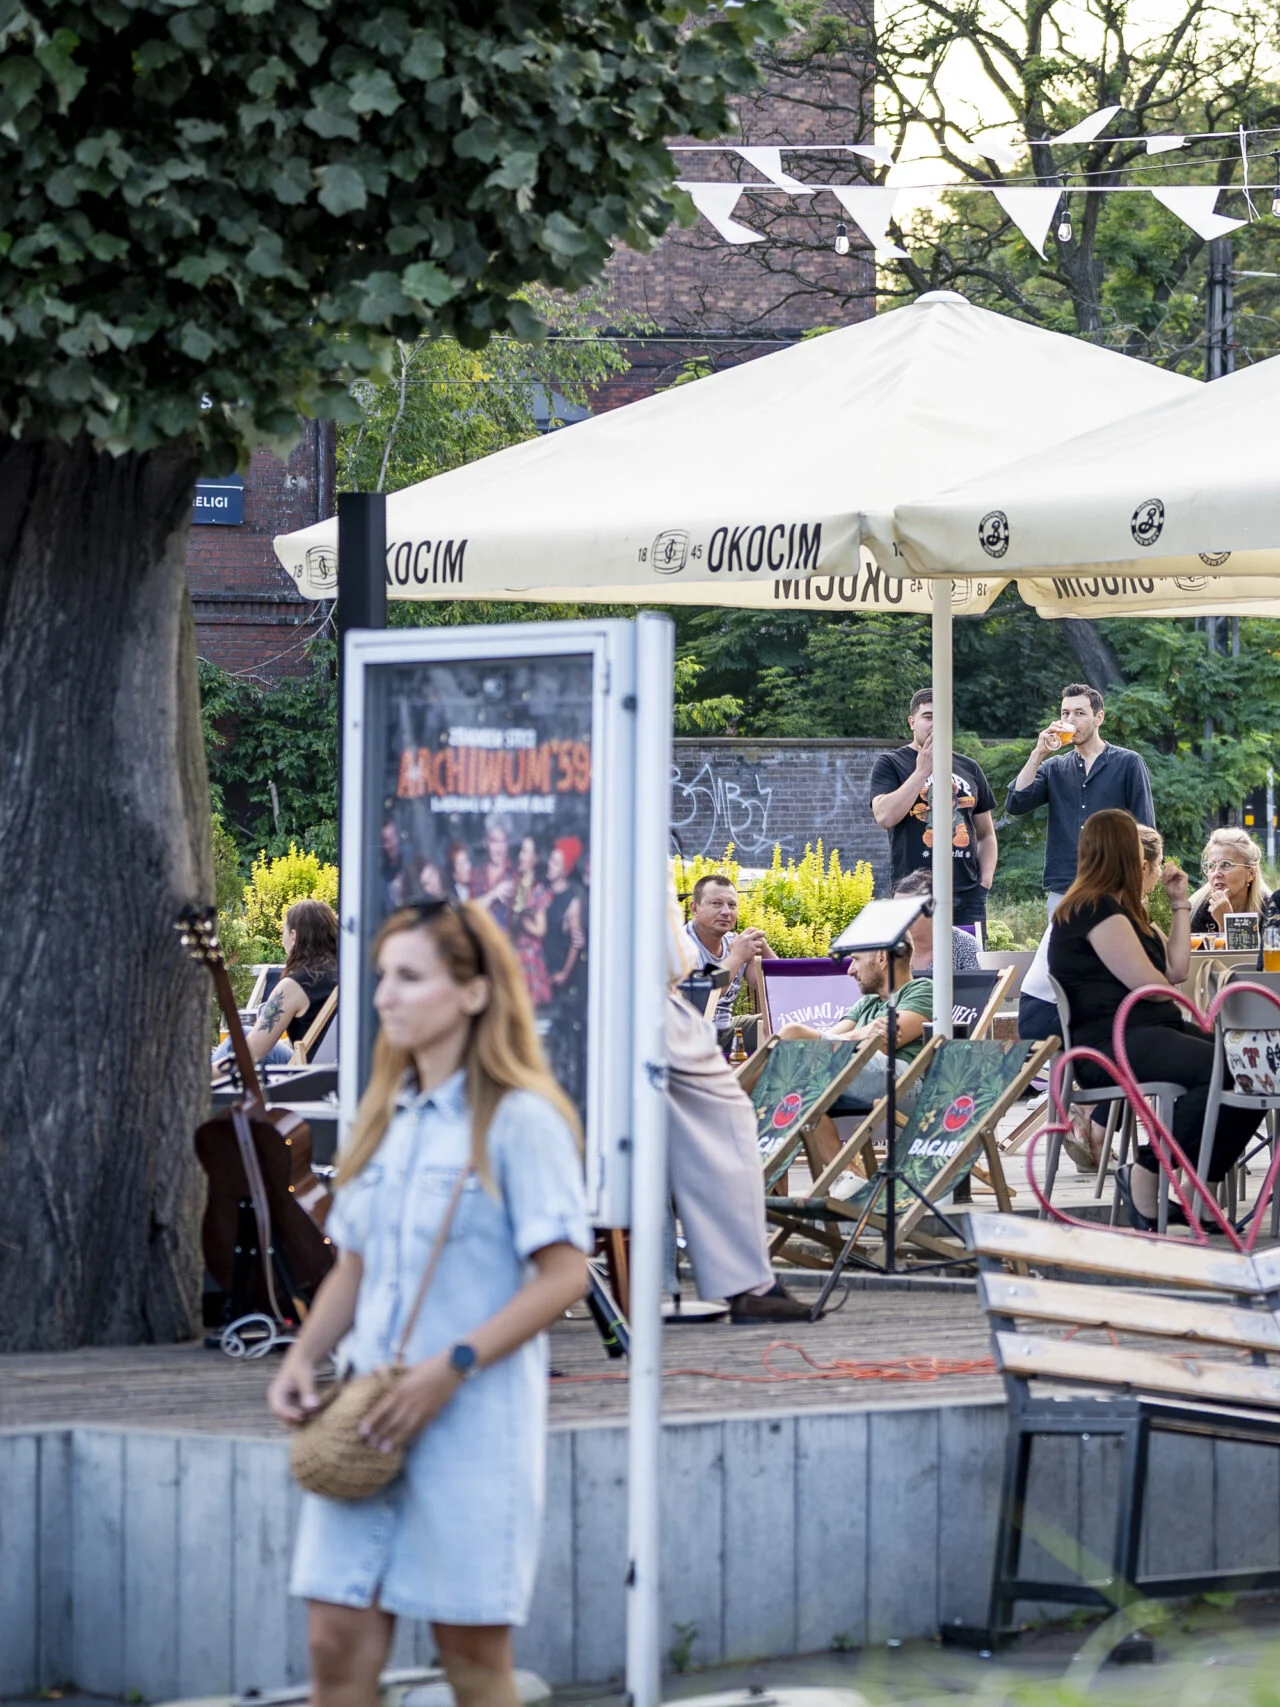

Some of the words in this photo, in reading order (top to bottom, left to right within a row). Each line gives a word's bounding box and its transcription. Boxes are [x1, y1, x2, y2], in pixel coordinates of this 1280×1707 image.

[193, 496, 228, 508] ELIGI
[386, 539, 468, 586] KOCIM
[691, 544, 703, 559] 45
[707, 523, 822, 573] OKOCIM
[908, 1138, 964, 1157] BACAR
